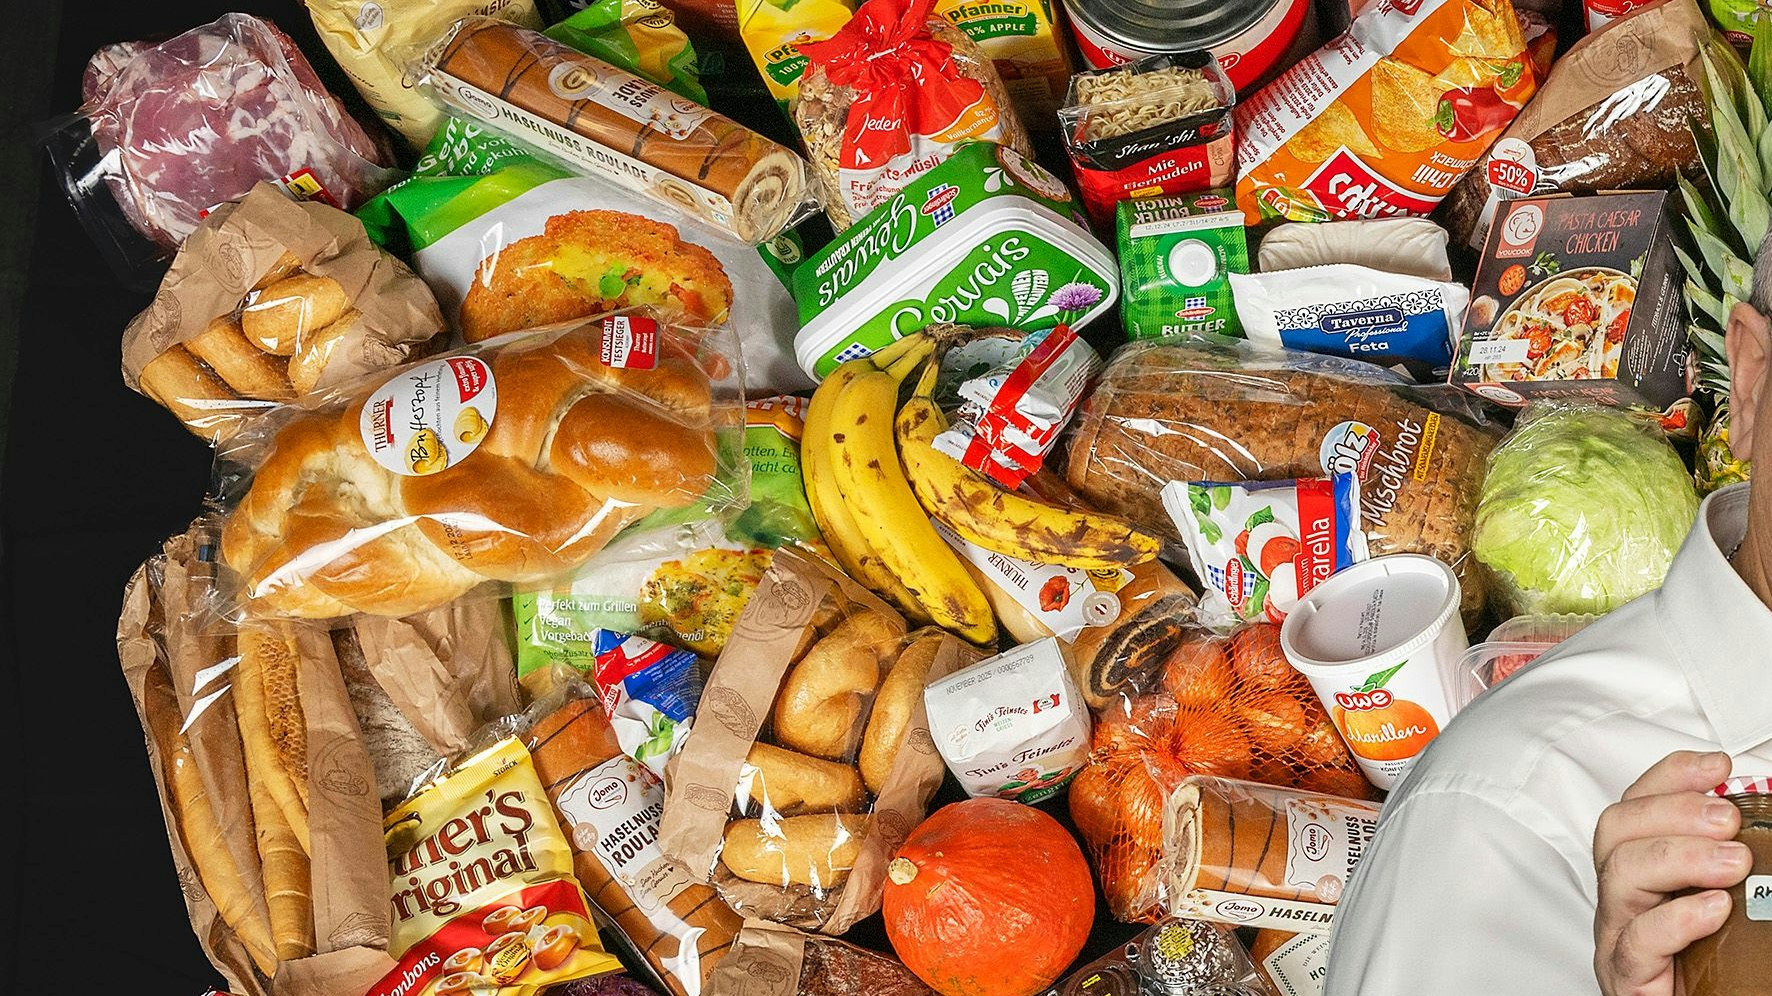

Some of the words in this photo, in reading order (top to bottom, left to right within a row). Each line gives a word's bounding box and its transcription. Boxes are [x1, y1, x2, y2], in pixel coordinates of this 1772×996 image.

[947, 3, 1023, 21] Pfanner
[990, 24, 1026, 33] APPLE
[853, 113, 902, 144] Jeden
[501, 106, 582, 151] HASELNUSS
[586, 144, 649, 183] ROULADE
[1123, 160, 1203, 190] Eiernudeln
[1148, 158, 1176, 176] Mie
[1492, 165, 1528, 188] -50%
[1135, 197, 1184, 211] MILCH
[1556, 212, 1595, 229] PASTA
[1597, 210, 1642, 229] CAESAR
[1566, 231, 1620, 254] CHICKEN
[1330, 313, 1395, 331] Taverna
[1344, 320, 1409, 342] Professional
[601, 320, 612, 363] KONSUMENT
[613, 320, 625, 363] TESTSIEGER
[1350, 342, 1389, 353] Feta
[373, 400, 388, 453] THURNER
[410, 372, 435, 462] Butterzopf
[1360, 418, 1421, 526] Mischbrot
[988, 552, 1029, 591] THURNER
[1229, 559, 1241, 603] Schärdinger
[578, 602, 600, 612] zum
[603, 600, 637, 613] Grillen
[539, 616, 571, 627] Vegan
[946, 680, 976, 695] NOVEMBER
[977, 671, 993, 684] 2025
[974, 713, 995, 733] Tini's
[996, 706, 1029, 720] Feinstes
[1348, 723, 1427, 744] Marillen
[492, 759, 518, 777] STORCK
[965, 761, 1008, 778] Tini's
[1012, 736, 1075, 765] Feinstes
[592, 780, 618, 802] Jomo
[600, 802, 663, 853] HASELNUSS
[1306, 828, 1317, 855] Jomo
[389, 830, 539, 921] riginal
[1224, 902, 1258, 912] Jomo
[1269, 906, 1334, 923] HASELN
